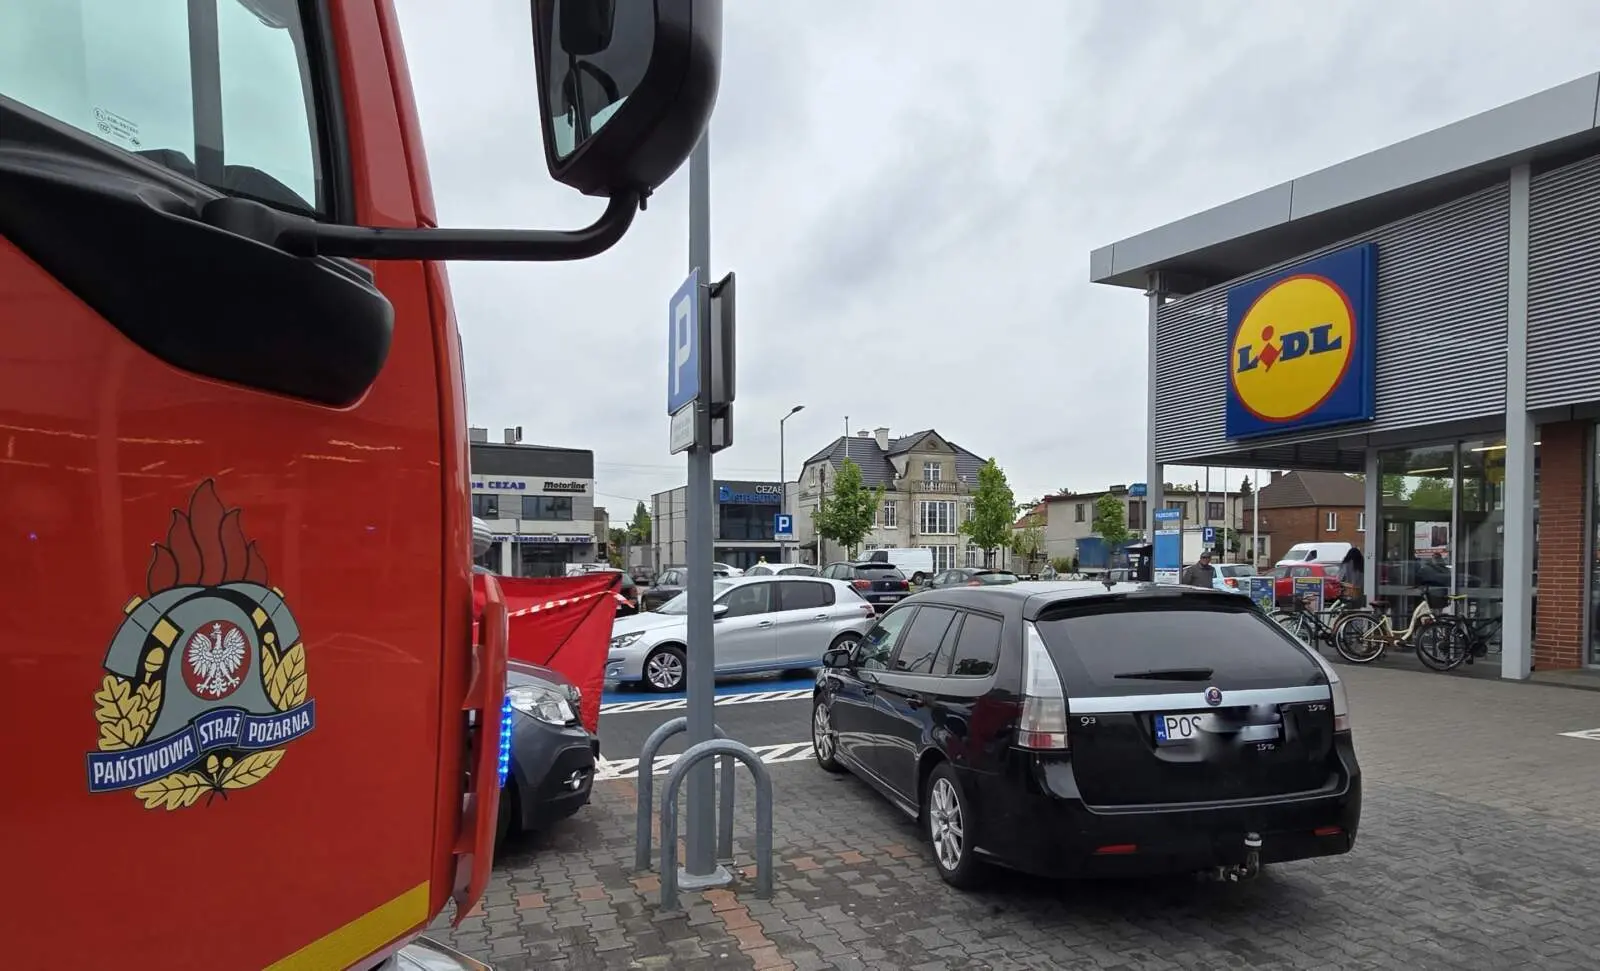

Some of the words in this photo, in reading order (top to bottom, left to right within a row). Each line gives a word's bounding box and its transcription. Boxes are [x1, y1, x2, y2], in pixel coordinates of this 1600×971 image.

[674, 294, 691, 396] P
[543, 481, 587, 491] Motorline
[778, 516, 790, 532] P
[1205, 528, 1213, 541] P
[93, 734, 194, 784] PAŃSTWOWA
[199, 713, 240, 744] STRAŻ
[248, 710, 310, 742] POŻARNA
